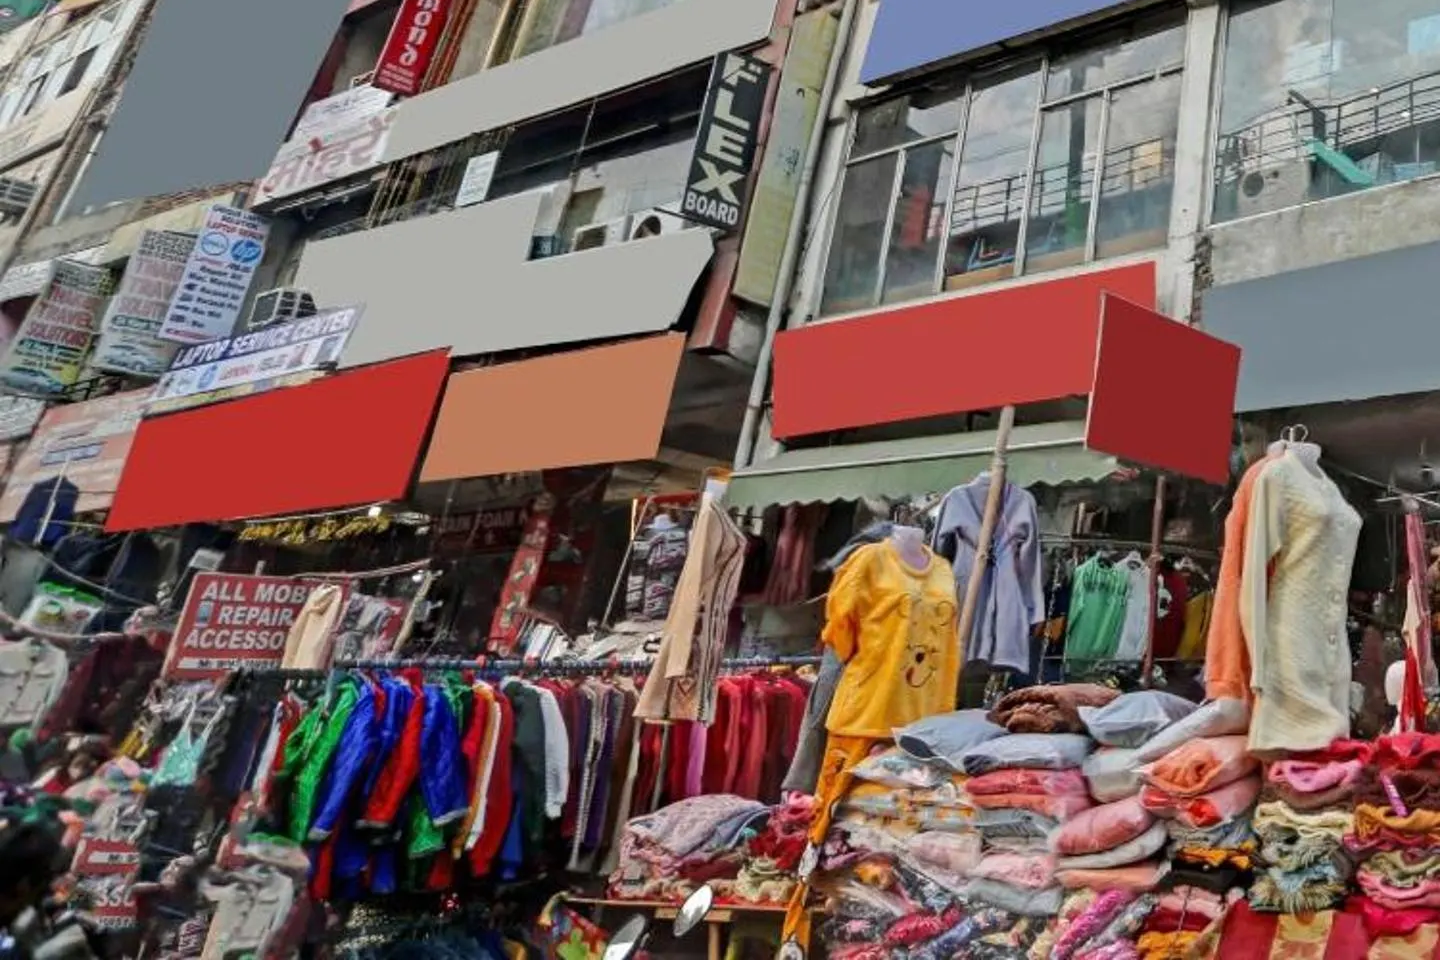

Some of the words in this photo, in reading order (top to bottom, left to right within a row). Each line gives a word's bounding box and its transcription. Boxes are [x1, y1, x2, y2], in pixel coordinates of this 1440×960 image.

[690, 53, 763, 206] FLEX
[684, 191, 739, 225] BOARD
[171, 339, 230, 371] LAPTOP
[201, 580, 246, 602] ALL
[254, 583, 311, 604] MOB
[217, 604, 293, 627] REPAIR
